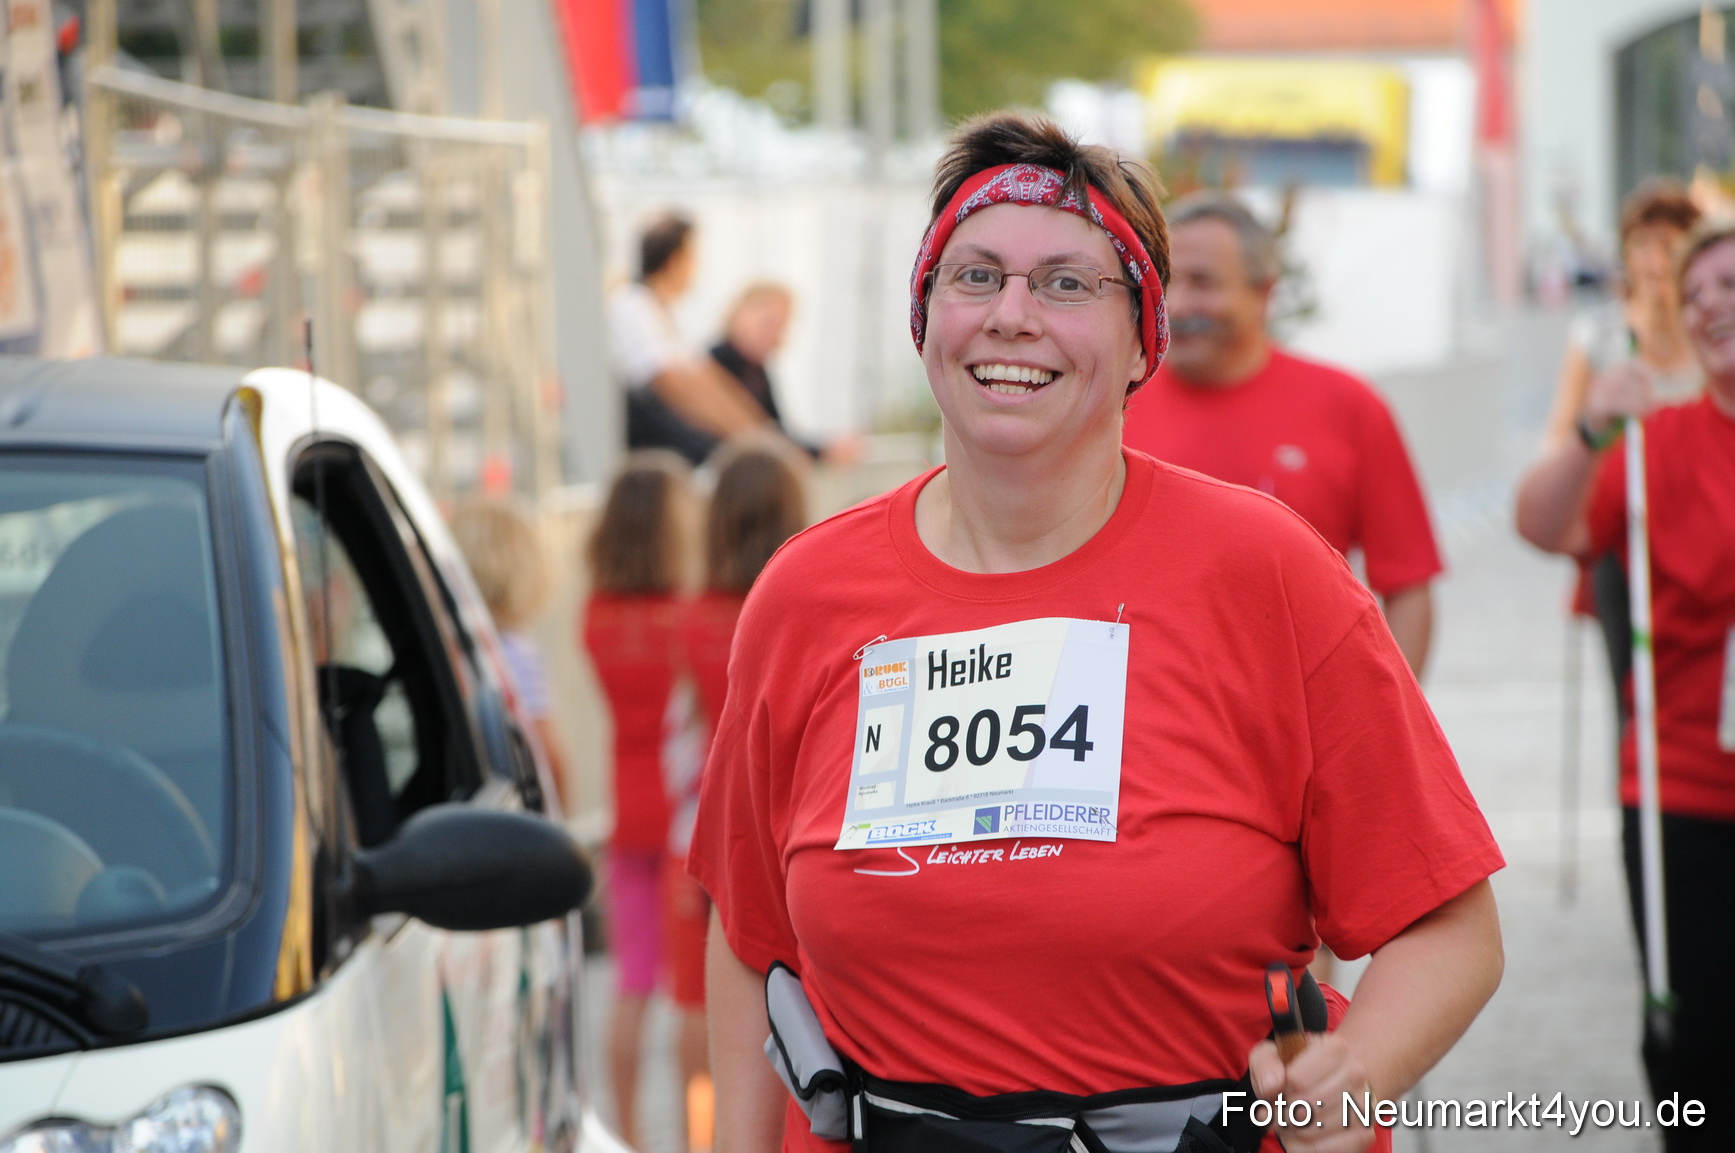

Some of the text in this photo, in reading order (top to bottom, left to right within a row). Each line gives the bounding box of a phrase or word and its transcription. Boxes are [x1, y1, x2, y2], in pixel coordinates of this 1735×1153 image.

[928, 643, 1012, 691] Heike
[879, 677, 908, 689] BÖGL
[865, 724, 882, 753] N
[924, 704, 1094, 773] 8054
[1004, 803, 1111, 824] PFLEIDERER
[867, 820, 937, 839] BOCK
[1003, 823, 1111, 836] AKTIENGESELLSCHAFT
[1009, 840, 1064, 861] LEBEN
